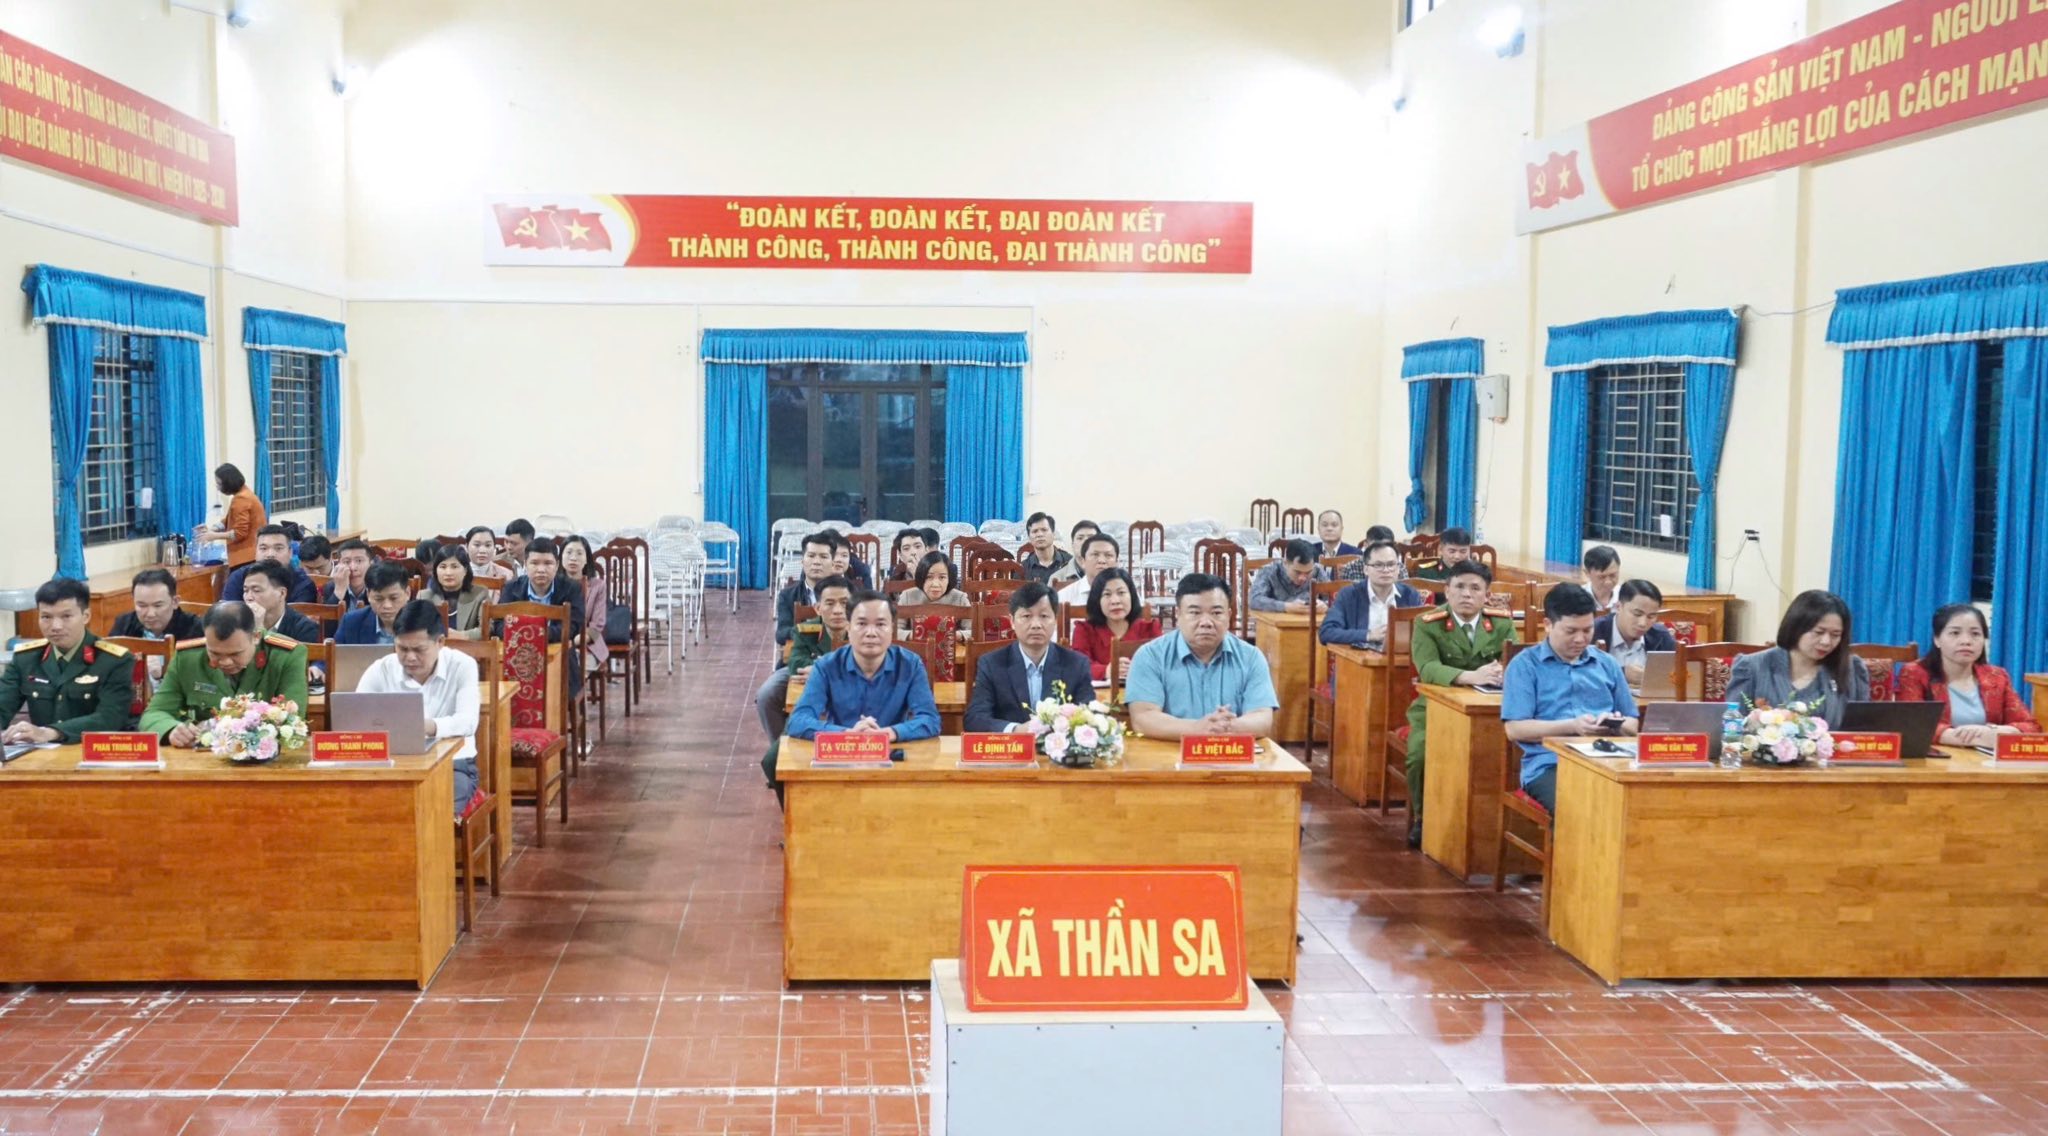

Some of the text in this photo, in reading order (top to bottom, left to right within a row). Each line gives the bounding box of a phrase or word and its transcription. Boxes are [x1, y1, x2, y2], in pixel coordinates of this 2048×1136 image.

[15, 55, 34, 94] CÁC
[34, 64, 54, 102] DÂN
[54, 72, 71, 113] TỘC
[1652, 98, 1696, 141] ĐẢNG
[1700, 85, 1748, 127] CỘNG
[1753, 58, 1794, 107] SẢN
[1799, 46, 1845, 93] VIỆT
[1849, 25, 1906, 76] NAM
[1632, 152, 1650, 192] TỔ
[1653, 145, 1695, 186] CHỨC
[1699, 137, 1732, 175] MỌI
[1736, 116, 1799, 163] THẮNG
[1804, 105, 1839, 149] LỢI
[1844, 80, 1891, 134] CỦA
[1898, 68, 1970, 118] CÁCH
[815, 203, 862, 231] KẾT,
[870, 205, 936, 230] ĐOÀN
[945, 204, 992, 232] KẾT,
[1000, 210, 1040, 236] ĐẠI
[1048, 207, 1113, 232] ĐOÀN
[1122, 206, 1166, 233] KẾT
[668, 233, 748, 259] THÀNH
[757, 234, 831, 261] CÔNG,
[838, 236, 918, 261] THÀNH
[924, 237, 999, 264] CÔNG,
[1007, 241, 1047, 266] ĐẠI
[1055, 238, 1133, 263] THÀNH
[93, 743, 110, 752] PHAN
[112, 743, 133, 752] TRUNG
[363, 742, 384, 751] PHONG
[821, 743, 832, 753] TẠ
[835, 740, 857, 753] VIỆT
[973, 741, 982, 753] LÊ
[1192, 743, 1202, 754] LÊ
[1205, 743, 1223, 756] VIỆT
[987, 898, 1227, 977] XÃ THẦN SA
